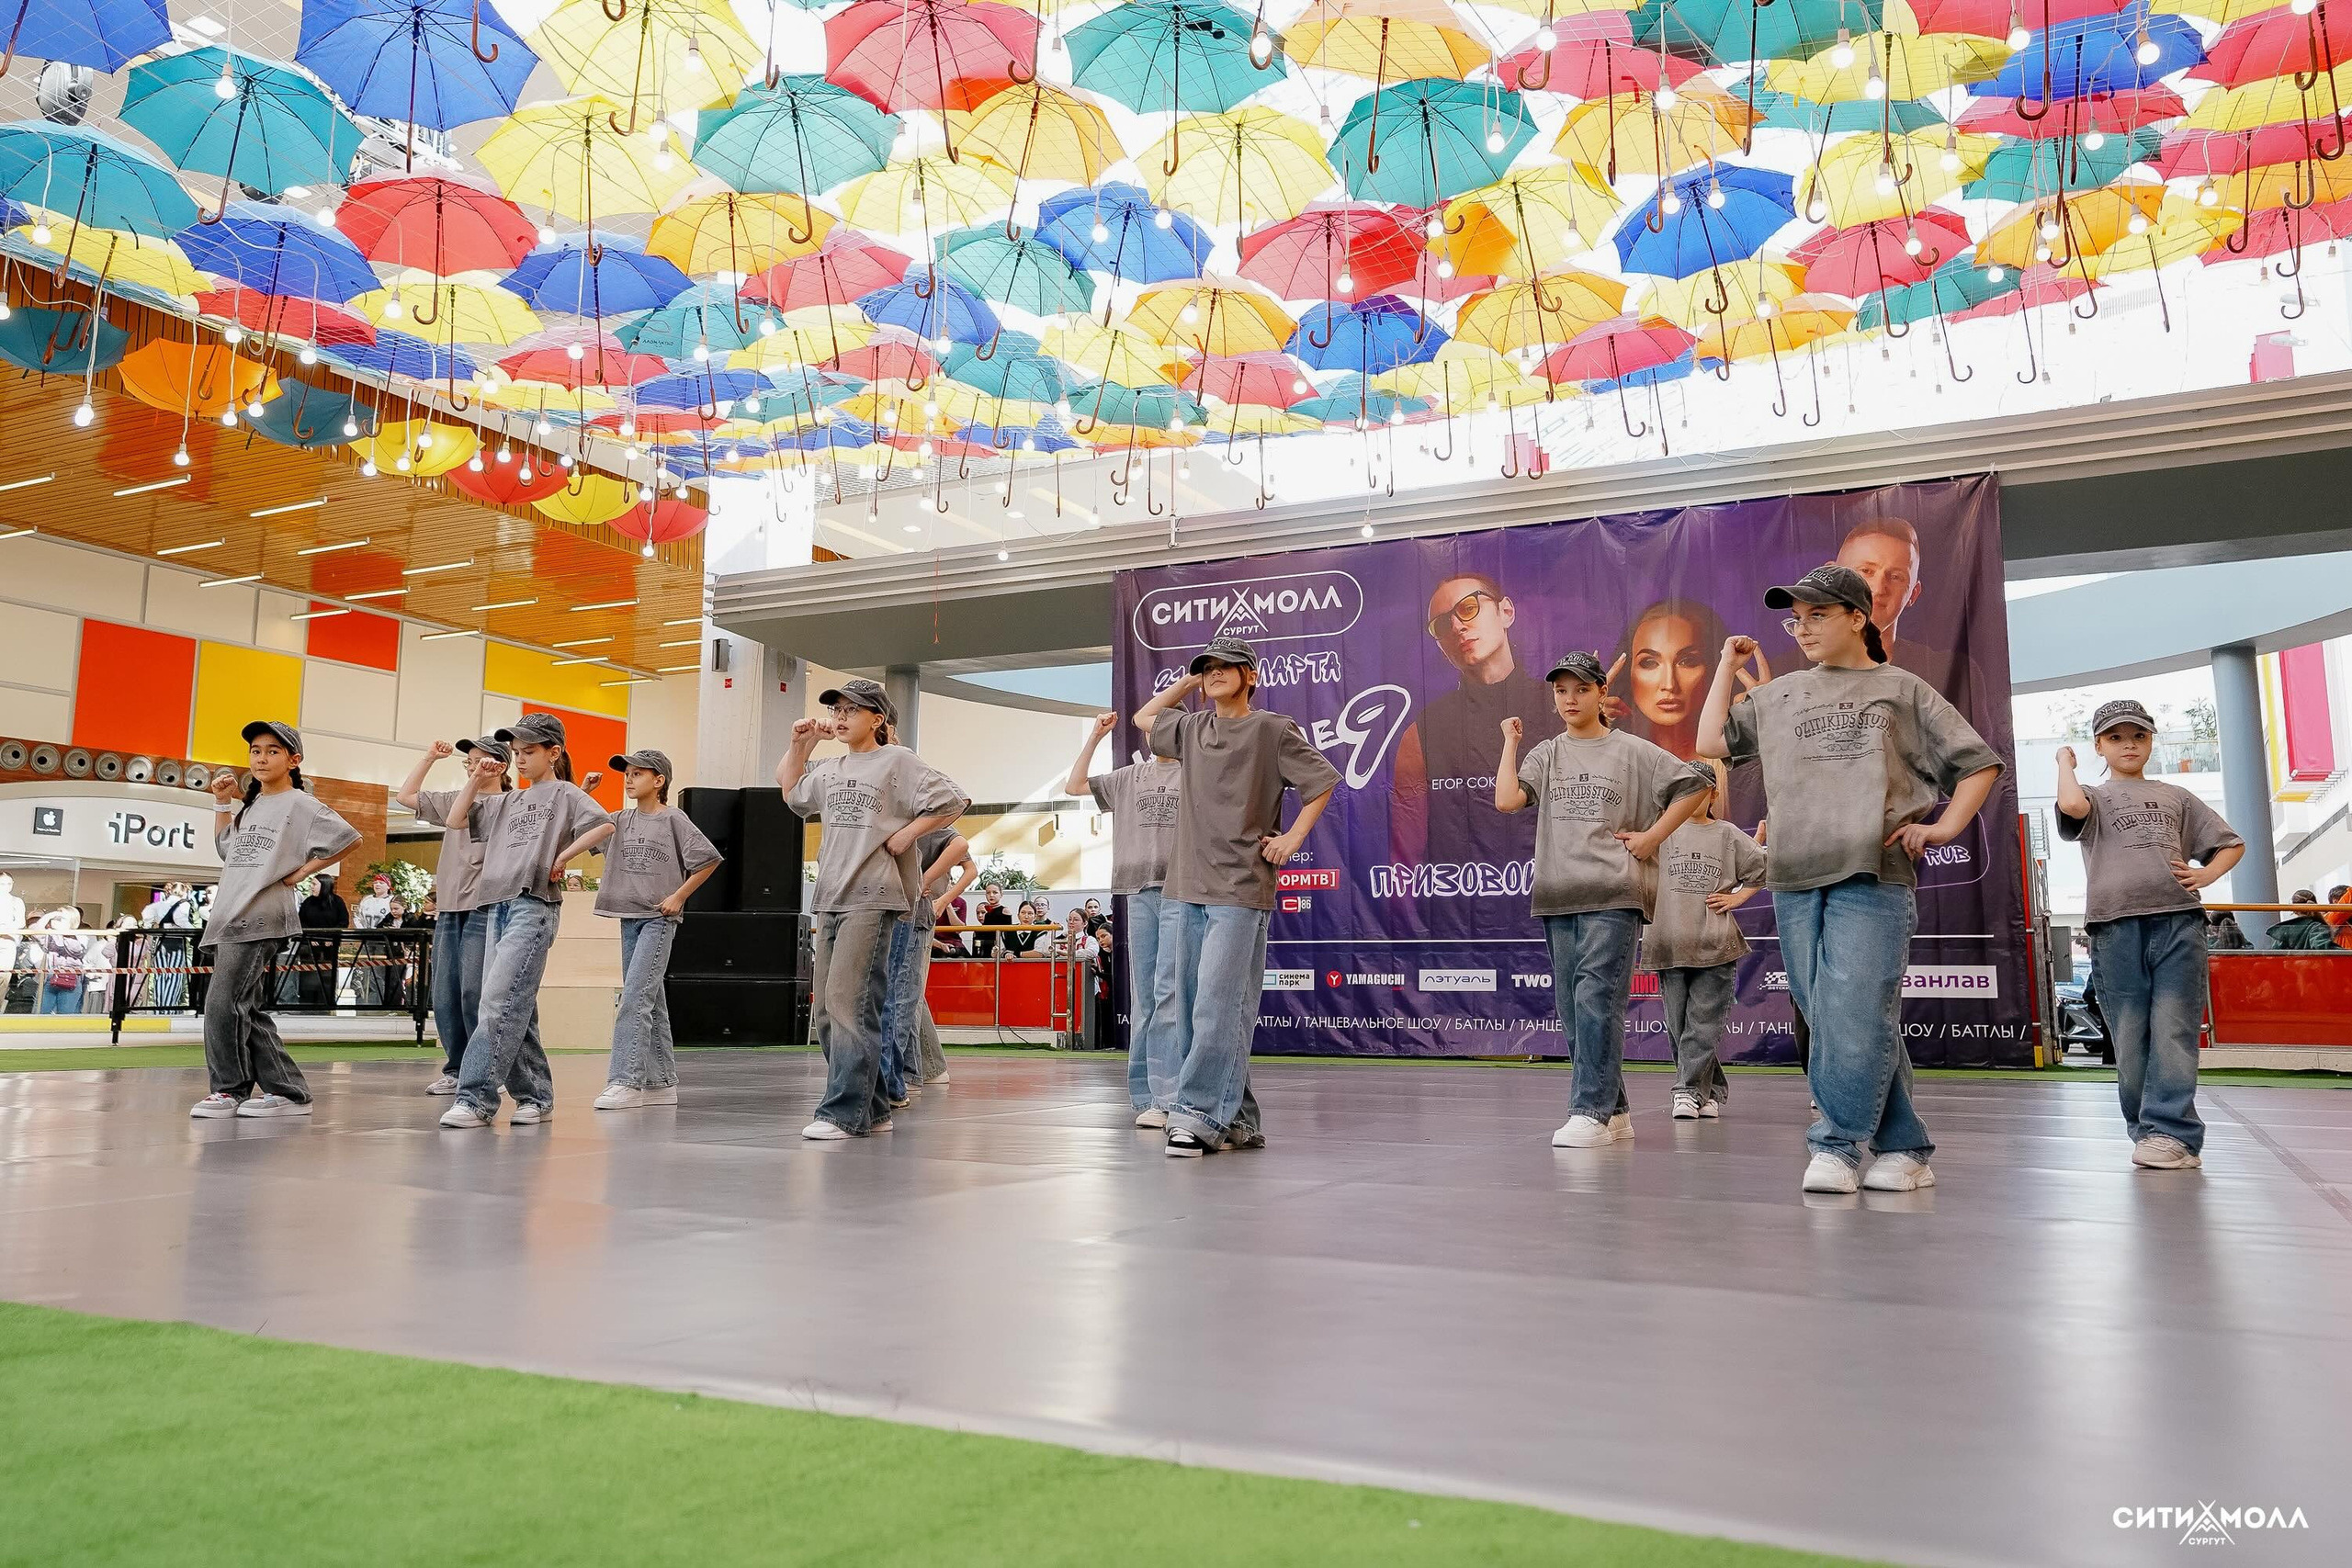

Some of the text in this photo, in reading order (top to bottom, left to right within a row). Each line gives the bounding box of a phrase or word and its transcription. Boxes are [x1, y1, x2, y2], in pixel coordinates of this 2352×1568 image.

[1151, 585, 1343, 625] СИТИ МОЛЛ
[1223, 625, 1260, 636] СУРГУТ
[1431, 778, 1464, 790] ЕГОР
[856, 793, 884, 814] STUDIO
[1591, 784, 1623, 807] STUDIO
[108, 812, 195, 850] iPort
[1278, 871, 1336, 887] ОРМТВ]
[1346, 974, 1405, 986] YAMAGUCHI
[1511, 974, 1553, 987] TWO
[1255, 1016, 1292, 1028] АТТЛЫ
[1304, 1016, 1404, 1030] ТАНЦЕВАЛЬНОЕ
[1408, 1017, 1442, 1030] ШОУ
[1454, 1018, 1505, 1031] БАТТЛЫ
[1951, 1024, 2014, 1038] БАТТЛЫ
